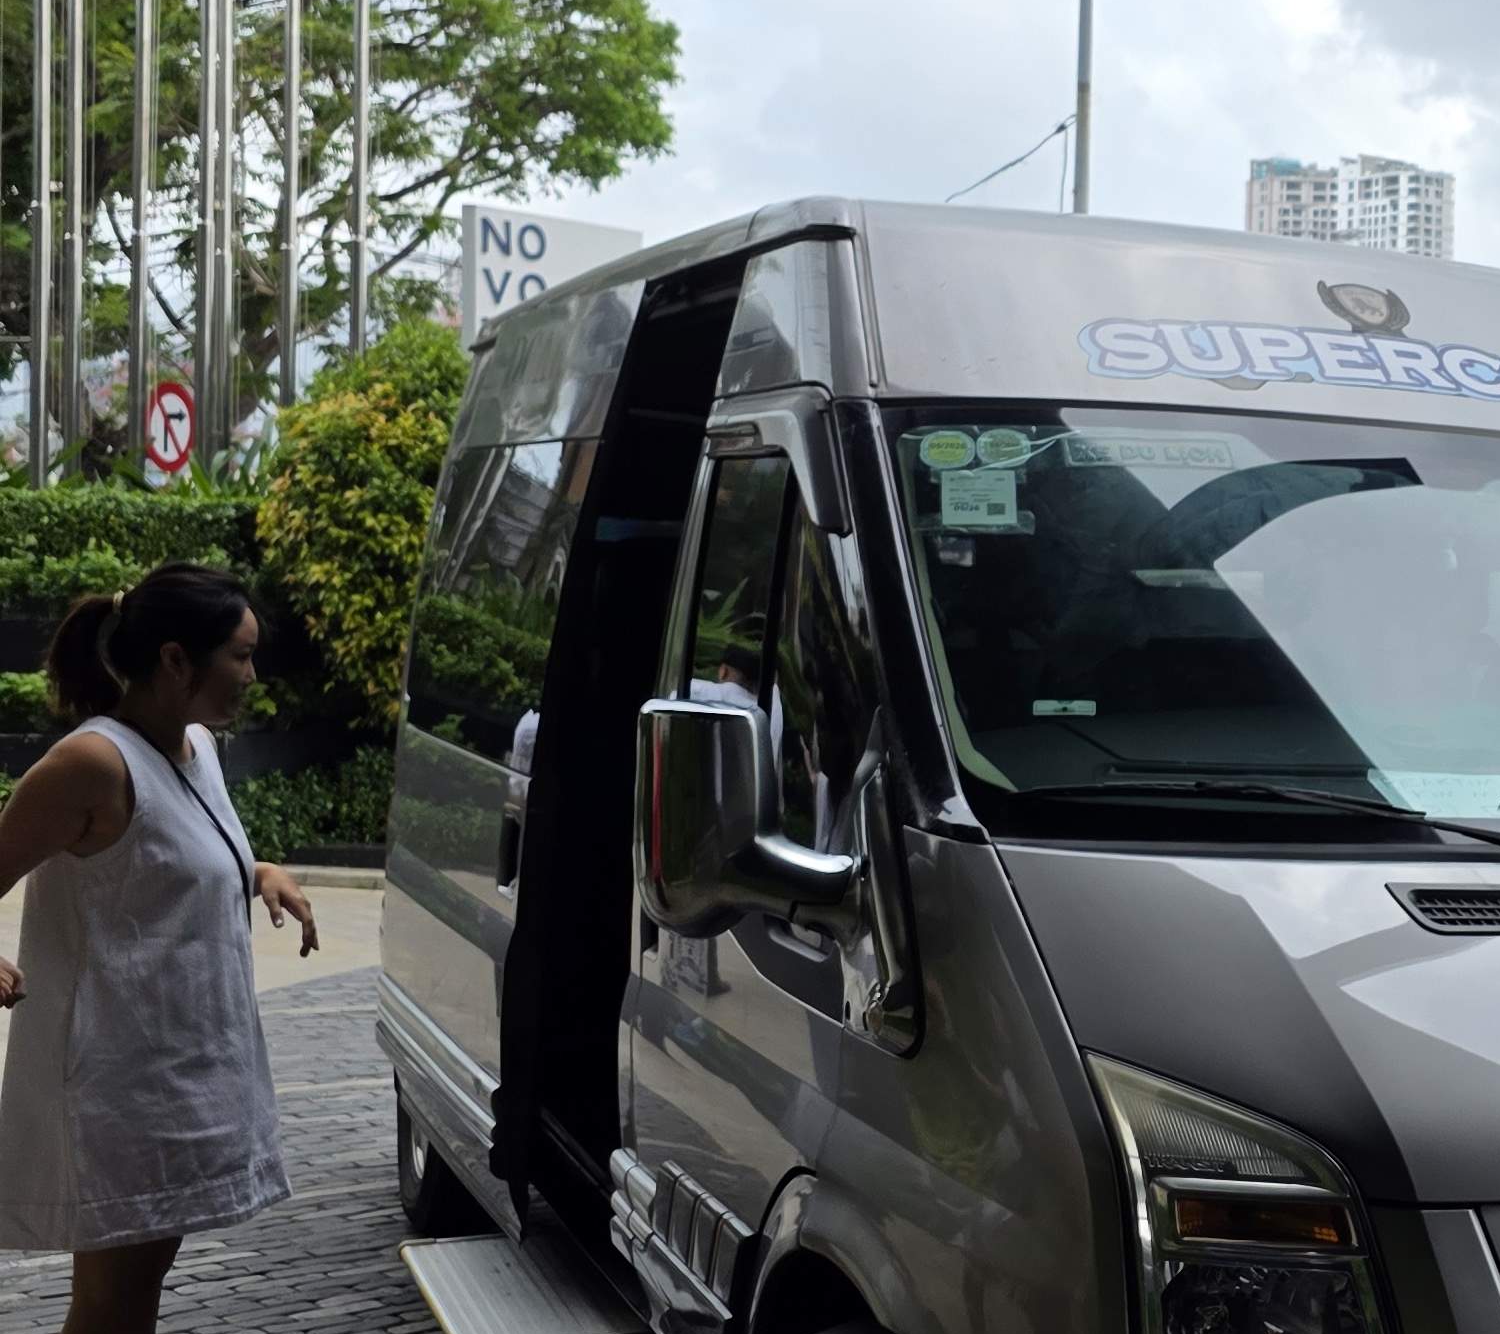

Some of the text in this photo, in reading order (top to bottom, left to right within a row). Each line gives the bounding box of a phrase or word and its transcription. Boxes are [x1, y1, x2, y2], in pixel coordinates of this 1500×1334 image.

[481, 217, 546, 260] NO
[1075, 444, 1111, 462] XE
[1119, 444, 1156, 460] DU
[1143, 1154, 1224, 1173] TRANSIT
